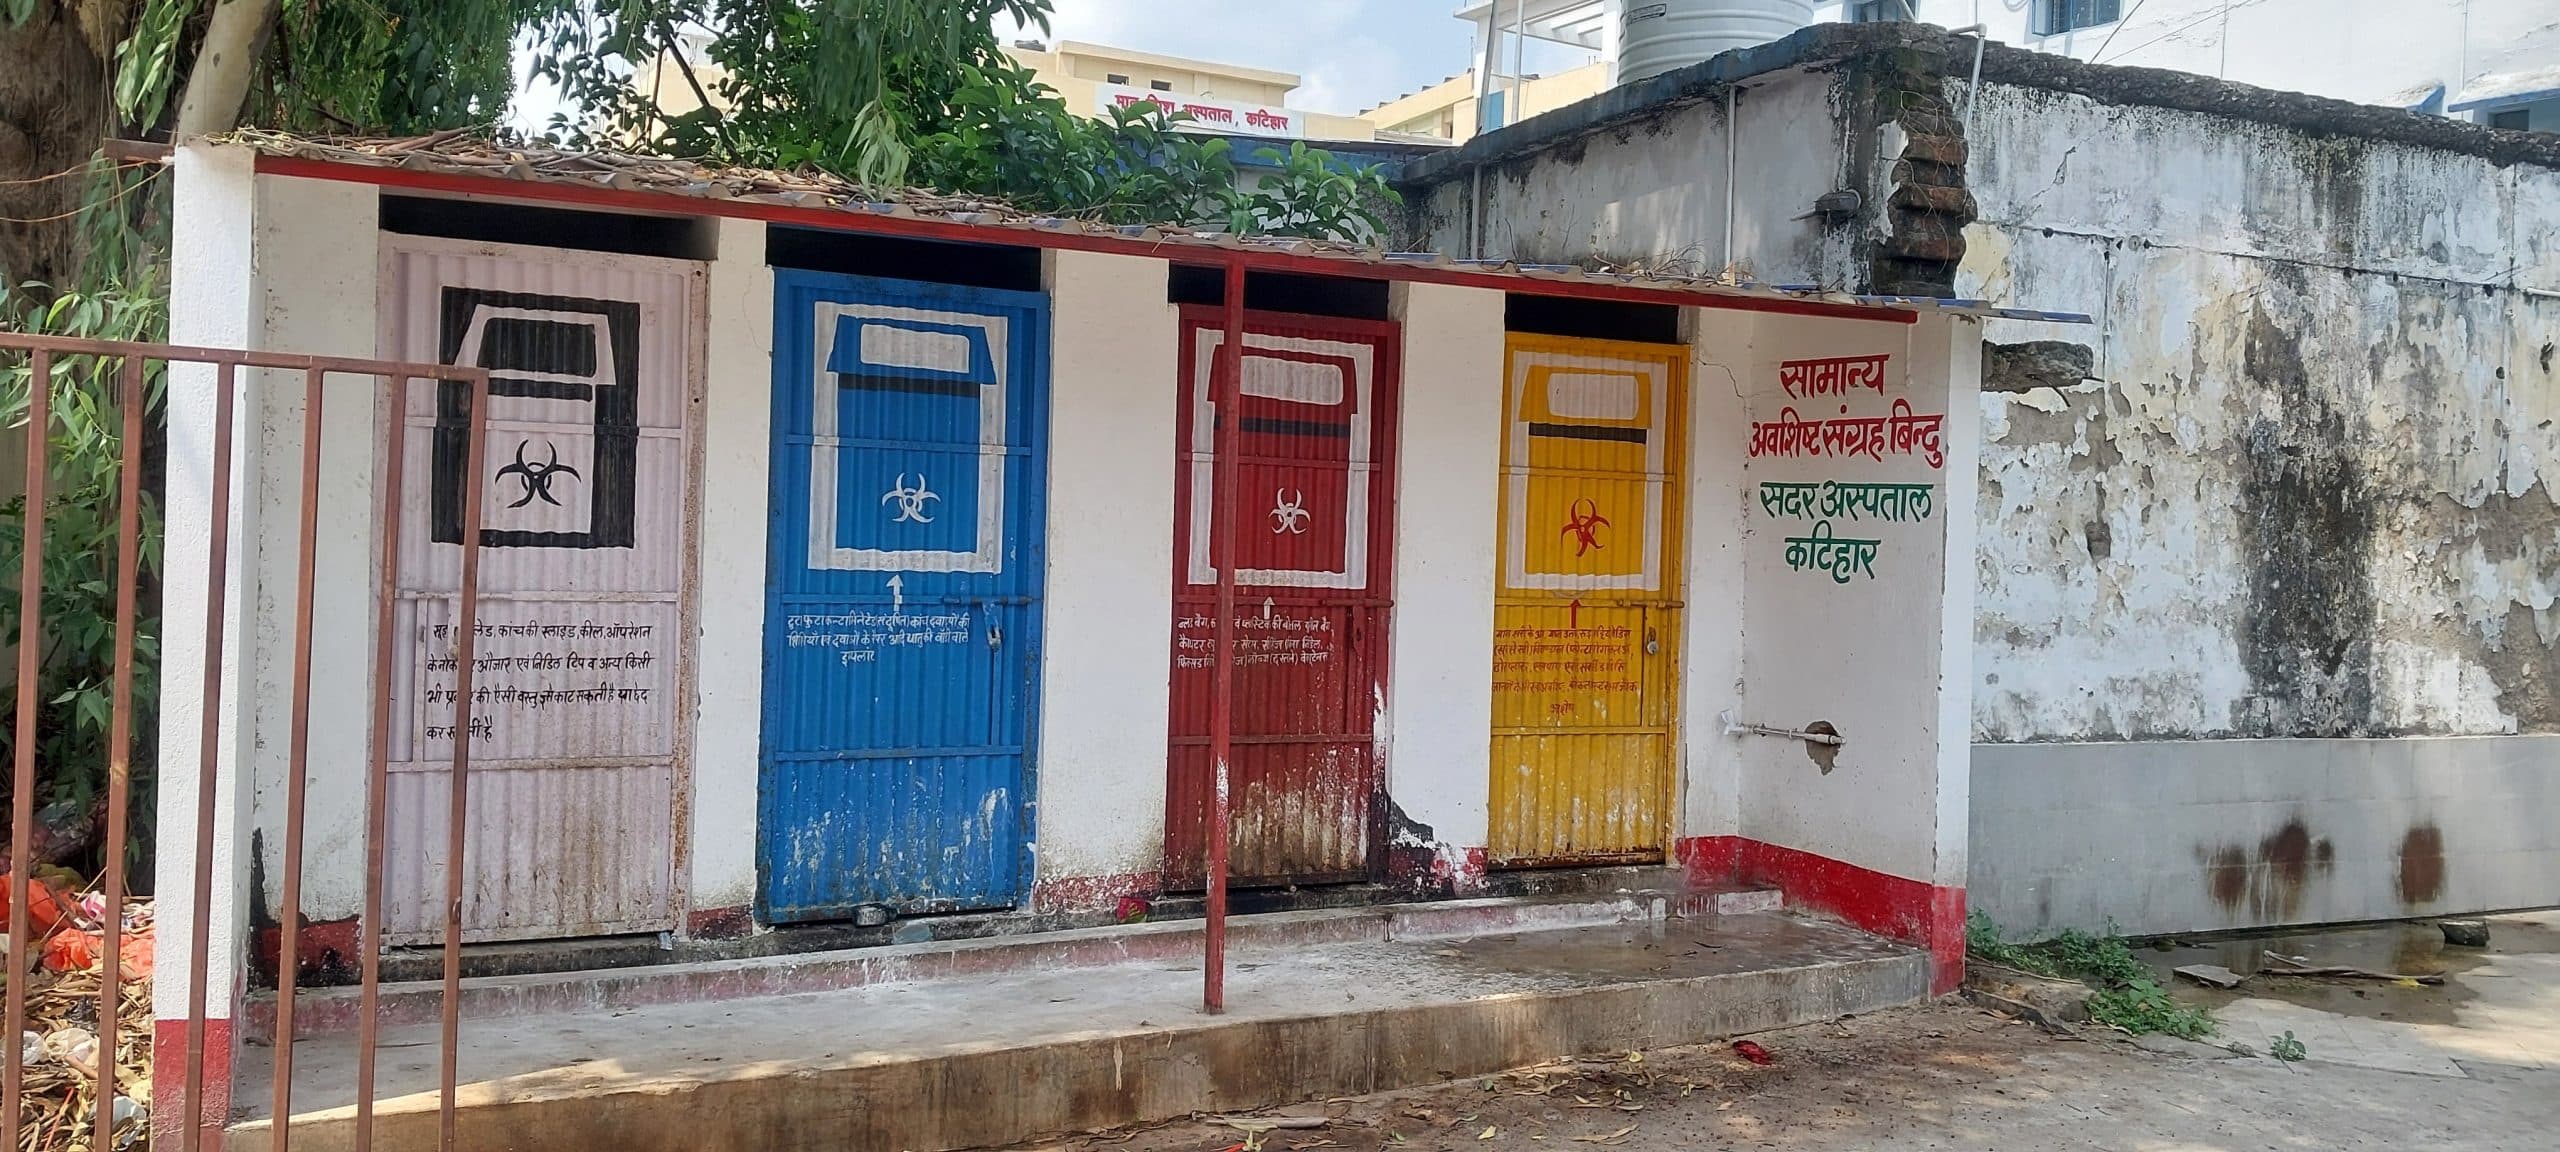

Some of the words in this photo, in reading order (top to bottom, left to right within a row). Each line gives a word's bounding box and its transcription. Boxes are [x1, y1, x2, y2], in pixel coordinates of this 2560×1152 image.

[1245, 109, 1289, 130] कटिहार
[1780, 354, 1890, 400] सामान्य
[1749, 406, 1822, 458] अवशिष्ट
[1823, 404, 1887, 463] संग्रह
[1889, 398, 1944, 469] बिन्दु
[1760, 481, 1819, 520] सदर
[1820, 480, 1934, 522] अस्पताल
[1784, 519, 1881, 584] कटिहार
[525, 619, 540, 637] की
[598, 657, 623, 671] अन्य
[625, 650, 655, 671] किसी
[427, 682, 442, 703] भी
[476, 686, 491, 703] की
[426, 727, 446, 740] कर
[483, 715, 493, 743] है
